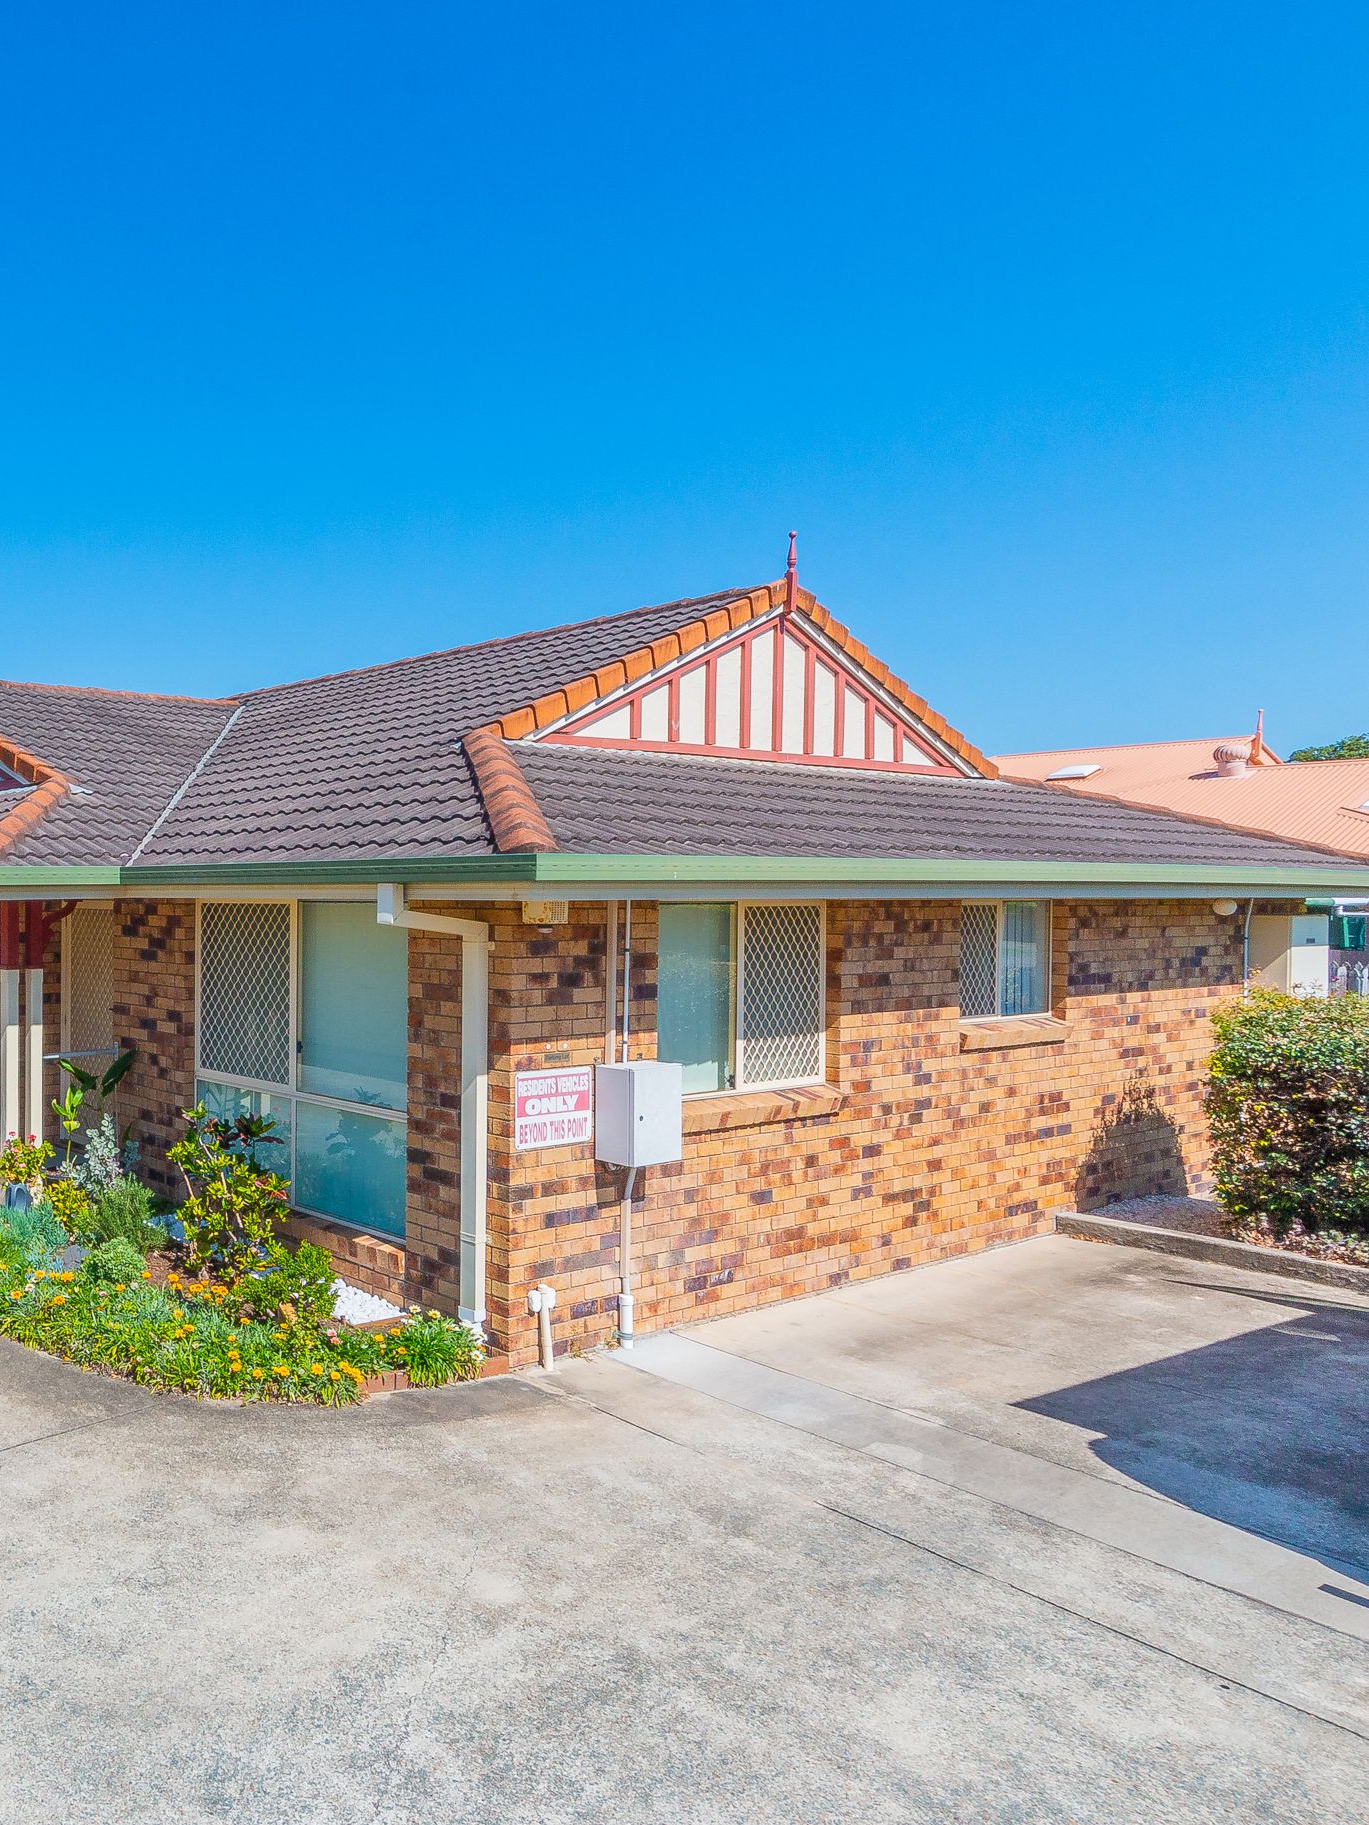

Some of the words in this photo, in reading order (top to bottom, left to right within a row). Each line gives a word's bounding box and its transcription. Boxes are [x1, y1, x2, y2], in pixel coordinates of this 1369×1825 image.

[518, 1078, 556, 1097] RESIDENTS
[557, 1075, 589, 1093] VEHICLES
[525, 1094, 579, 1116] ONLY
[519, 1122, 548, 1145] BEYOND
[550, 1119, 565, 1141] THIS
[567, 1117, 588, 1138] POINT
